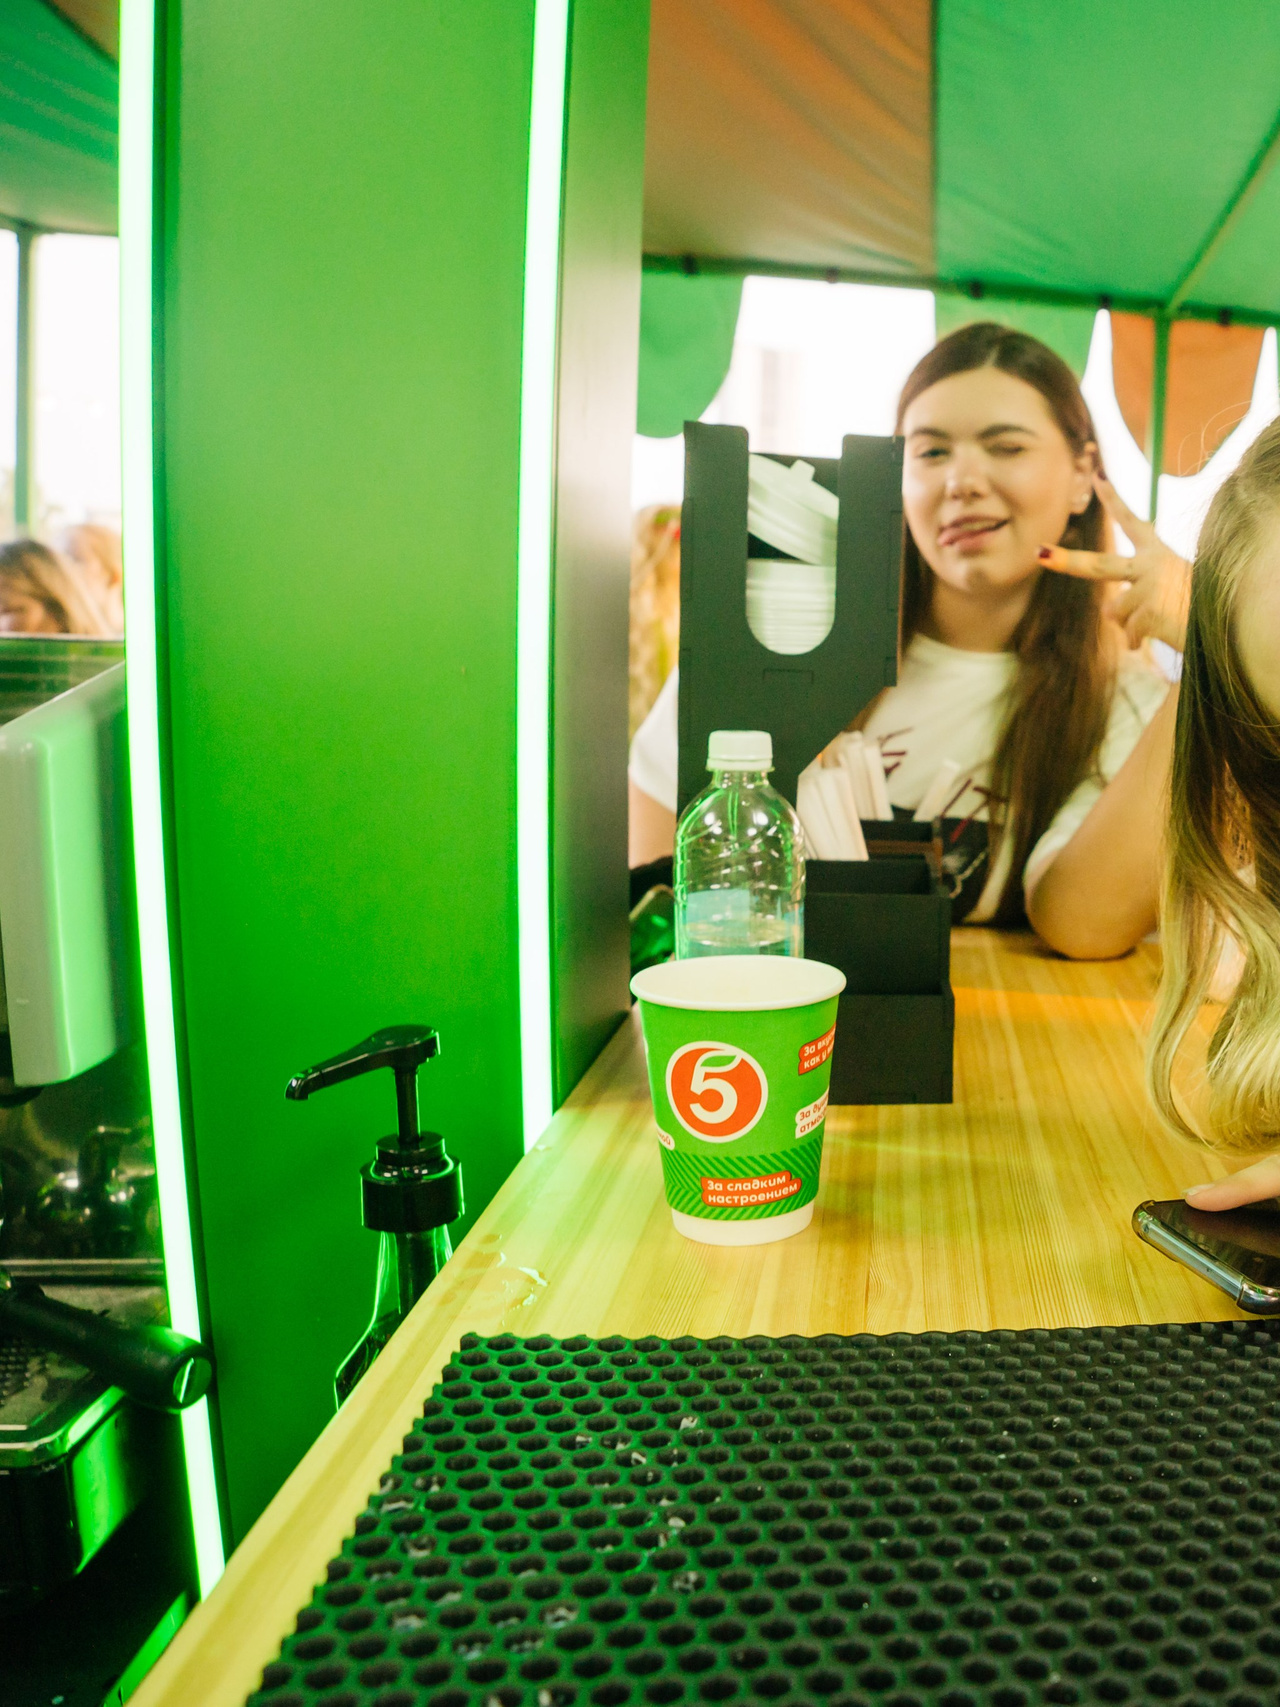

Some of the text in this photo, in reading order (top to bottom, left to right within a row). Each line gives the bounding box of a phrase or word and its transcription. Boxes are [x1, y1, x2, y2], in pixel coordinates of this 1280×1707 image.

[803, 1044, 816, 1057] За
[803, 1055, 821, 1070] как
[689, 1049, 740, 1124] 5
[799, 1110, 811, 1122] За
[707, 1175, 786, 1191] За сладким
[708, 1183, 798, 1206] настроением
